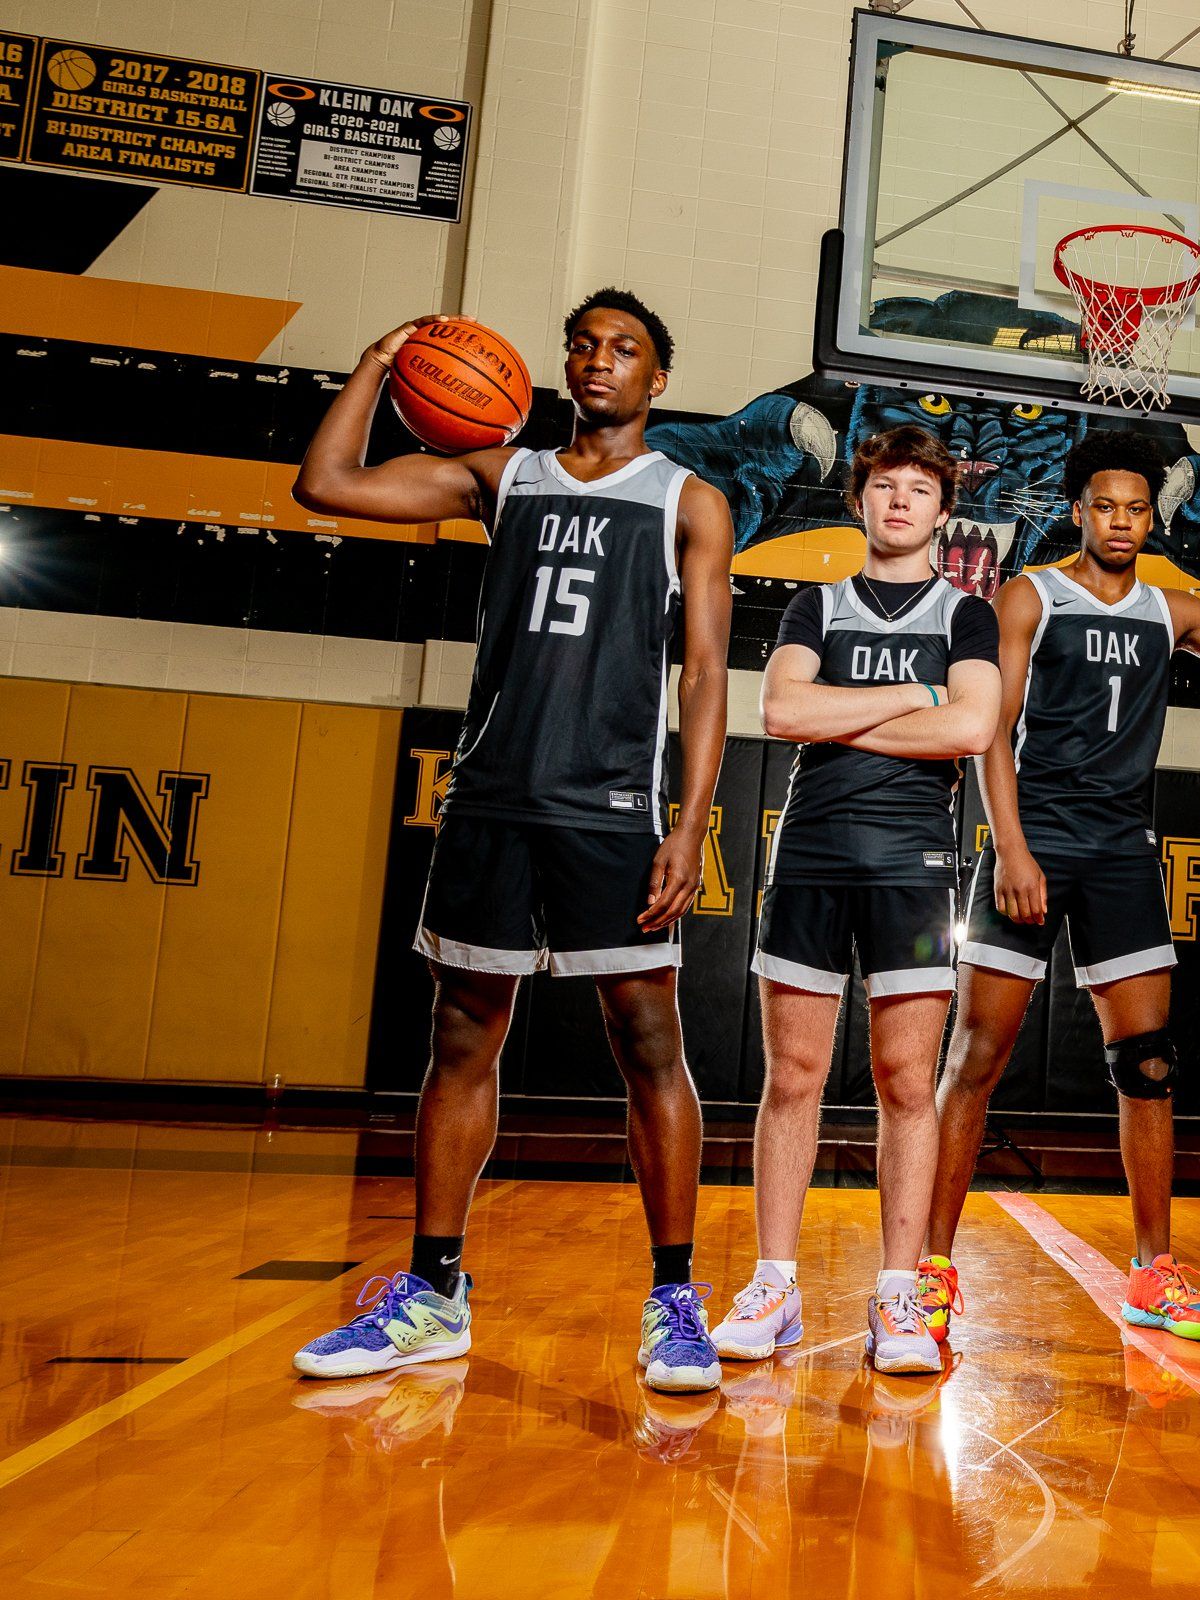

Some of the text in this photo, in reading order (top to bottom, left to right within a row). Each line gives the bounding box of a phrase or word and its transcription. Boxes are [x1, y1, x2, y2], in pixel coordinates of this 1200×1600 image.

[102, 80, 247, 112] GIRLS BASKETBALL
[108, 59, 169, 84] 2017
[187, 70, 247, 96] 2018
[51, 91, 236, 133] DISTRICT 15-6A
[319, 88, 415, 119] KLEIN OAK
[46, 119, 159, 148] BI-DISTRICT
[160, 136, 236, 159] CHAMPS
[303, 123, 422, 151] GIRLS BASKETBALL
[330, 113, 399, 133] 2020-2021
[62, 142, 216, 176] AREA FINALISTS
[323, 153, 399, 170] BI-DISTRICT CHAMPIONS
[329, 145, 396, 160] DISTRICT CHAMPIONS
[333, 164, 387, 177] AREA CHAMPIONS
[299, 177, 414, 198] REGIONAL SEMI-FINALIST CHAMPIONS
[303, 169, 334, 179] REGIONAL
[350, 175, 378, 185] FINALIST
[380, 179, 415, 190] CHAMPIONS
[428, 324, 513, 385] Wilson
[409, 354, 493, 407] EVOLUTION
[538, 513, 611, 557] OAK
[528, 565, 596, 637] 15
[851, 645, 919, 682] OAK
[1085, 628, 1140, 667] OAK
[1107, 674, 1122, 733] 1
[0, 758, 211, 887] IN
